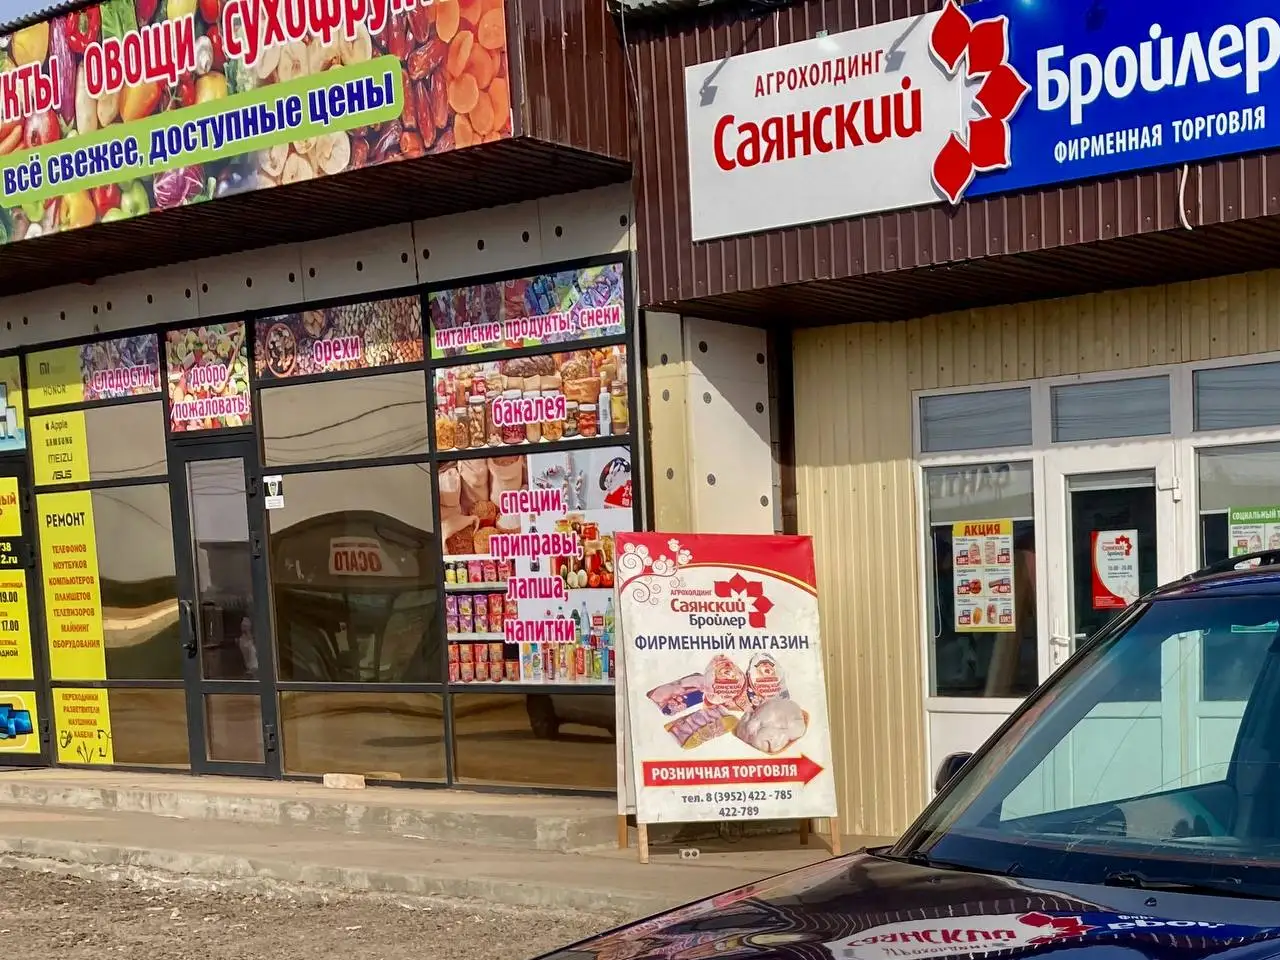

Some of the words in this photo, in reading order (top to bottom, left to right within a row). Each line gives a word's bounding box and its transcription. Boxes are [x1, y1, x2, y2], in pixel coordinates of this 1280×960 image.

[86, 16, 195, 95] овощи
[755, 50, 884, 98] АГРОХОЛДИНГ
[3, 155, 42, 195] всё
[47, 137, 144, 184] свежее,
[150, 95, 302, 164] доступные
[308, 72, 394, 125] цены
[714, 77, 922, 172] Саянский
[1054, 124, 1163, 164] ФИРМЕННАЯ
[1172, 106, 1266, 144] ТОРГОВЛЯ
[435, 321, 500, 349] китайские
[505, 310, 574, 341] продукты,
[580, 305, 621, 328] снеки
[313, 335, 360, 366] орехи
[94, 365, 151, 391] сладости
[191, 364, 227, 387] добро
[175, 393, 249, 419] пожаловать!
[492, 396, 567, 426] бакалея
[500, 489, 567, 515] специи,
[46, 512, 85, 528] РЕМОНТ
[965, 524, 1001, 537] АКЦИЯ
[490, 533, 583, 561] приправы,
[507, 577, 568, 602] лапша,
[670, 598, 745, 613] Саянский
[505, 619, 576, 643] напитки
[689, 614, 746, 629] Бройлер
[635, 633, 735, 651] ФИРМЕННЫЙ
[739, 635, 809, 650] МАГАЗИН
[652, 766, 730, 781] РОЗНИЧНАЯ
[732, 764, 798, 778] ТОРГОВЛЯ
[681, 793, 704, 803] тел.
[706, 793, 713, 802] 8
[714, 790, 747, 803] (3952)
[748, 790, 767, 801] 422
[774, 790, 792, 800] 785
[719, 806, 759, 817] 422-789
